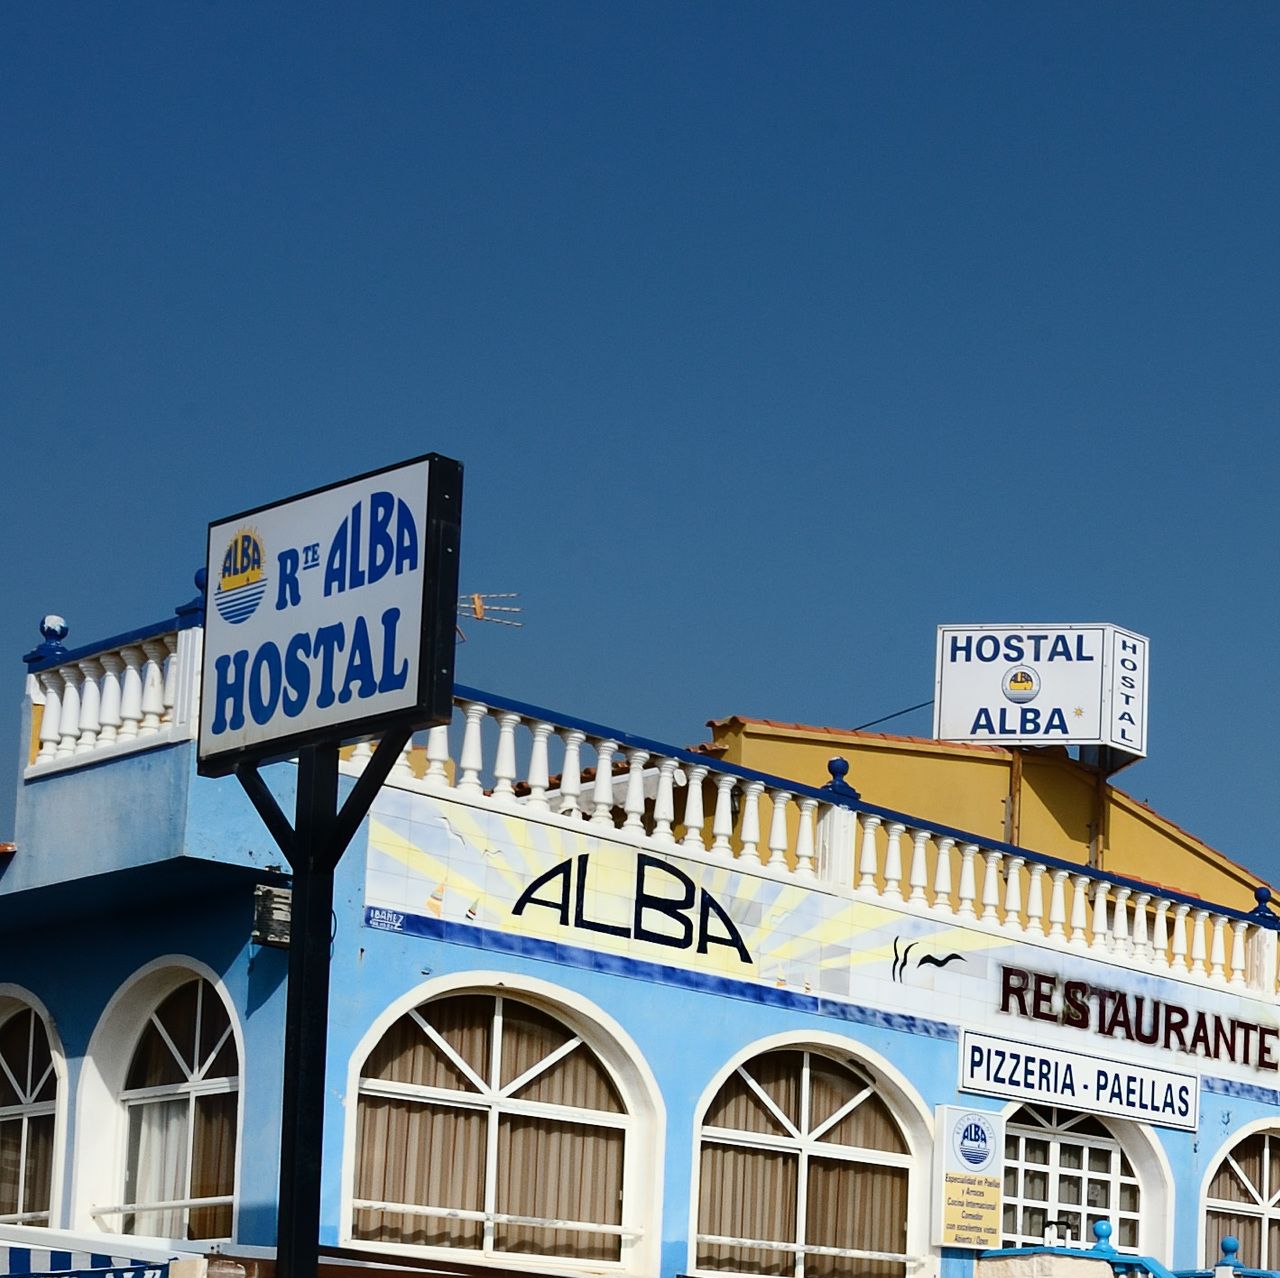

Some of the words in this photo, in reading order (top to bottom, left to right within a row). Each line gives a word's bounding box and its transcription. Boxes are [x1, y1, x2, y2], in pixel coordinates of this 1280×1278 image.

[222, 535, 261, 578] ALBA
[324, 491, 418, 597] ALBA
[211, 607, 409, 735] HOSTAL
[950, 634, 1094, 663] HOSTAL
[1118, 640, 1137, 743] HOSTAL
[970, 707, 1069, 735] ALBA
[512, 853, 753, 964] ALBA
[1000, 965, 1280, 1072] RESTAURANTE
[970, 1045, 1075, 1098] PIZZERIA
[1097, 1070, 1189, 1118] PAELLAS
[962, 1123, 987, 1143] ALBA
